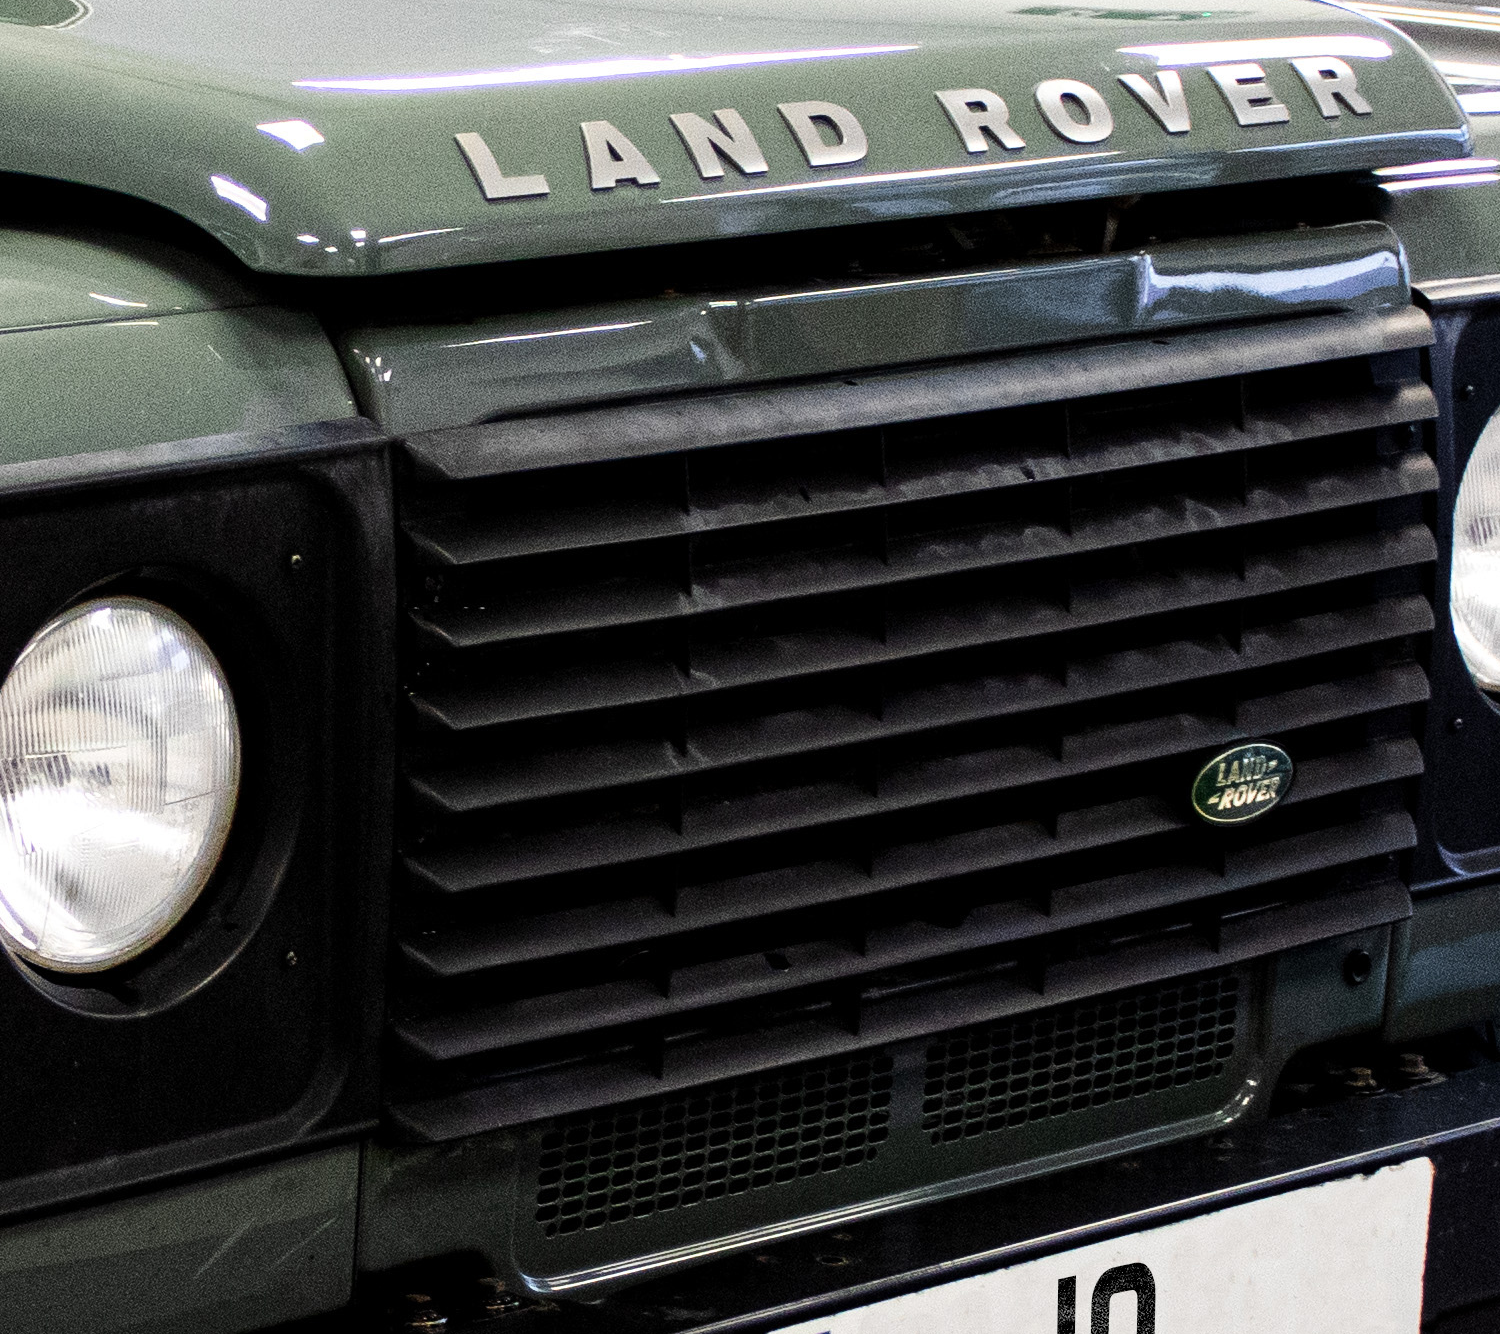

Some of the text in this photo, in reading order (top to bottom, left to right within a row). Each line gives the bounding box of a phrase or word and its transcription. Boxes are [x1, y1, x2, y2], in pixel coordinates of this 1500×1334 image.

[453, 55, 1374, 200] LAND ROVER
[1216, 755, 1267, 787] LAND
[1217, 777, 1281, 811] ROVER
